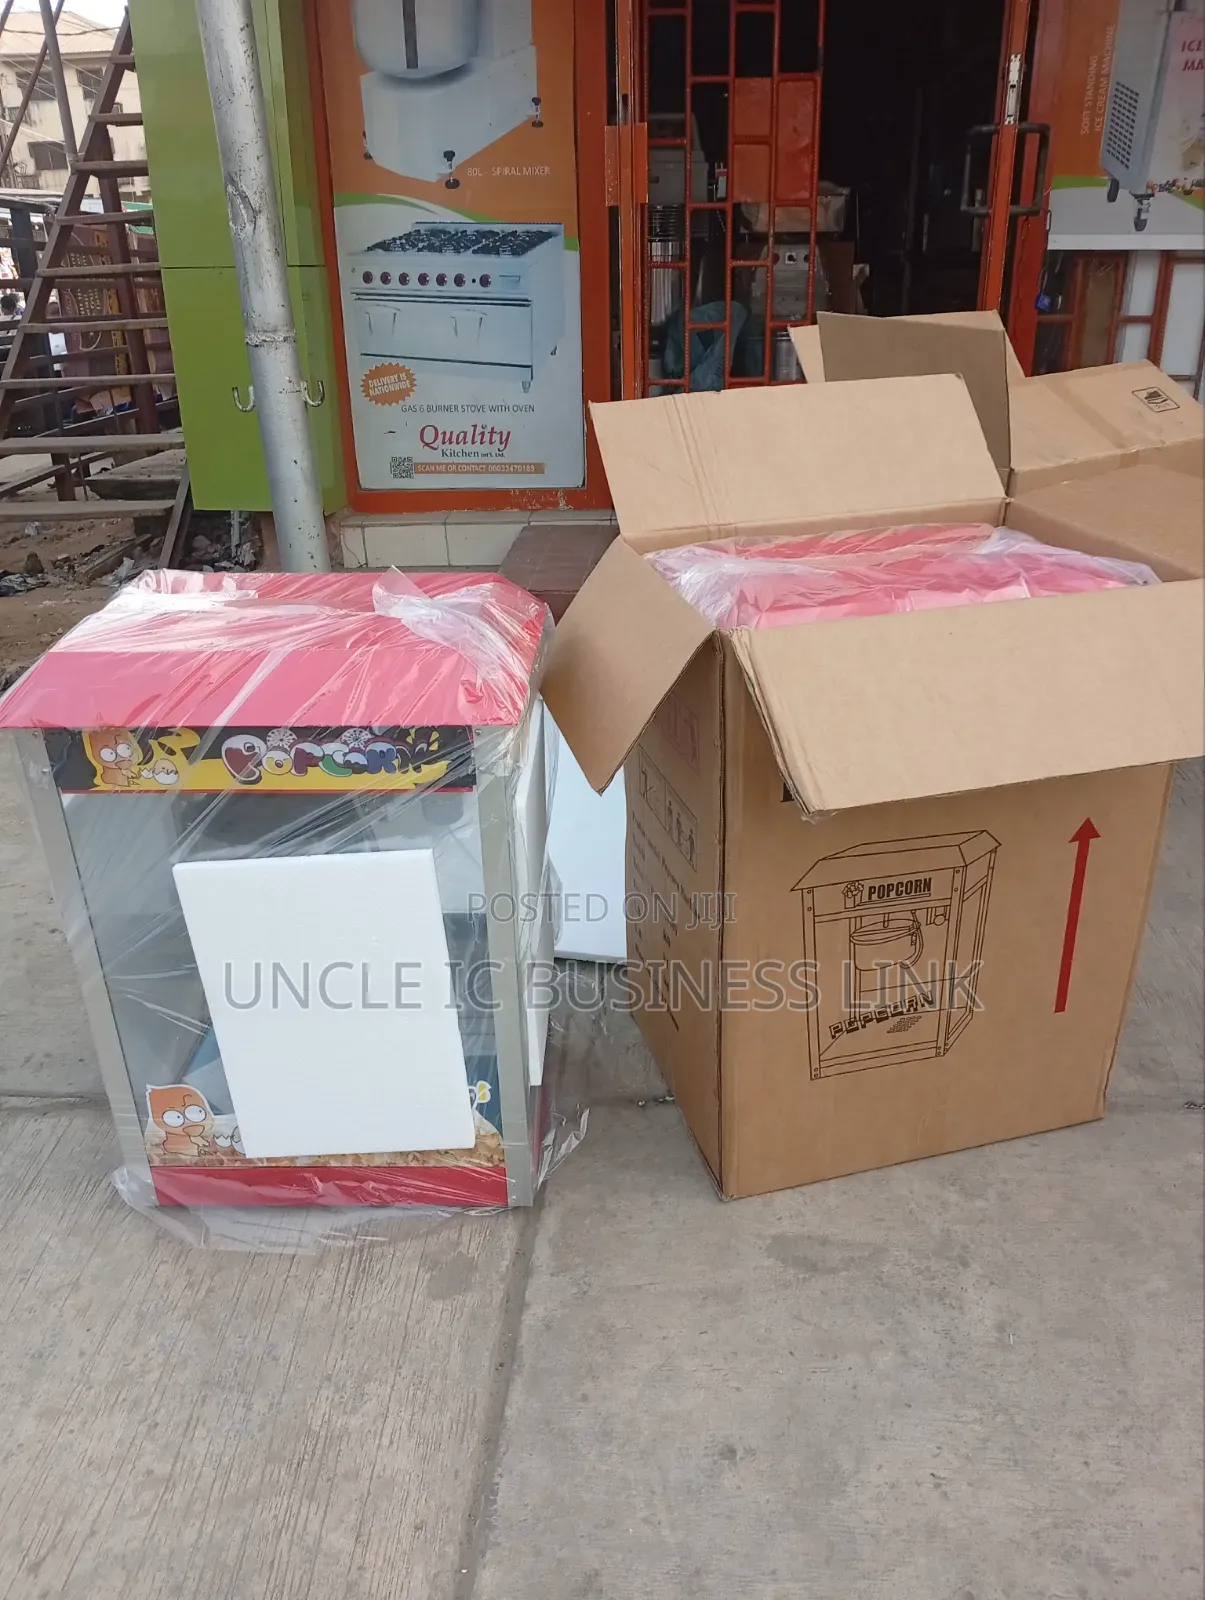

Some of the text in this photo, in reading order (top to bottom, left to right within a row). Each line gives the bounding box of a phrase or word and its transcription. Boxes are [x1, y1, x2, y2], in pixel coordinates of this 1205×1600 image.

[1094, 24, 1115, 132] ICE CREAM MACHINE
[1081, 55, 1098, 135] SOFT STANDING
[491, 166, 521, 176] SPIRAL
[522, 166, 551, 176] MIXER
[368, 372, 408, 389] DELIVERY IS
[369, 379, 411, 397] NATIONWIDE
[401, 405, 417, 413] GAS
[426, 405, 459, 413] BURNER
[461, 405, 486, 413] STOVE
[488, 405, 510, 413] WITH
[512, 405, 535, 413] OVEN
[419, 423, 511, 452] Quality
[441, 449, 480, 458] Kitchen
[417, 464, 435, 472] SCAN
[436, 464, 446, 472] ME
[447, 464, 457, 472] OR
[458, 464, 486, 472] CONTACT
[868, 877, 932, 900] POPCORN
